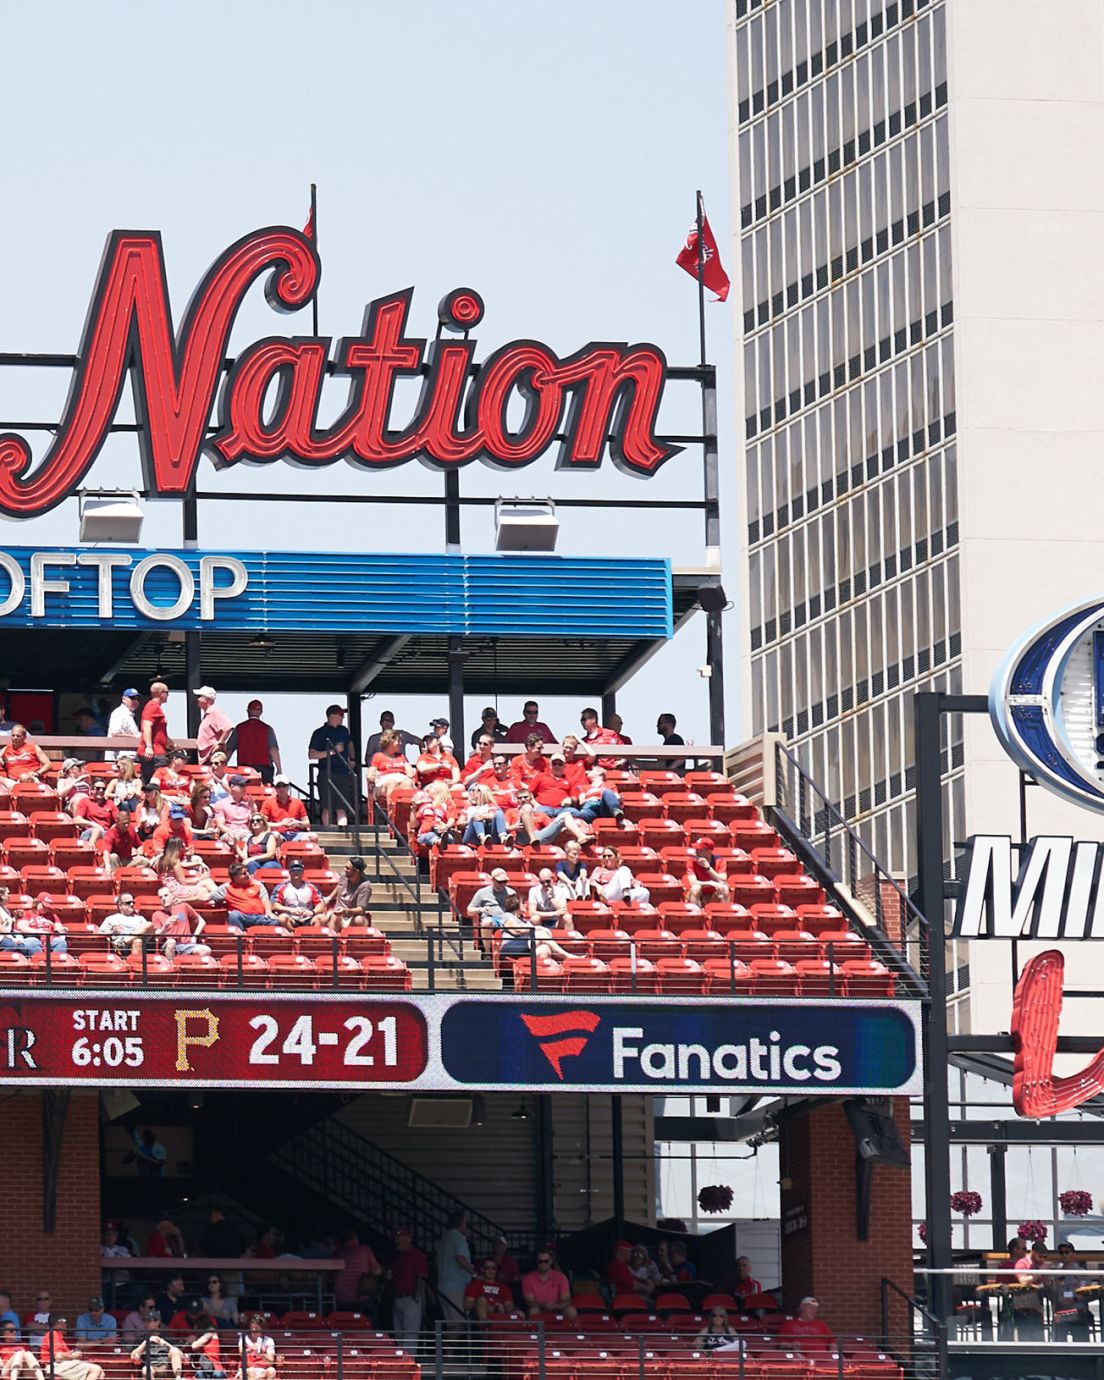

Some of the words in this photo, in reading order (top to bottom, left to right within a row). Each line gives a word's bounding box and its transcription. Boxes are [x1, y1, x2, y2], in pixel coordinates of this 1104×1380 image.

[956, 835, 1104, 938] MI
[73, 1009, 141, 1032] START
[248, 1014, 399, 1067] 24-21
[71, 1037, 145, 1068] 6:05
[613, 1027, 841, 1081] Fanatics
